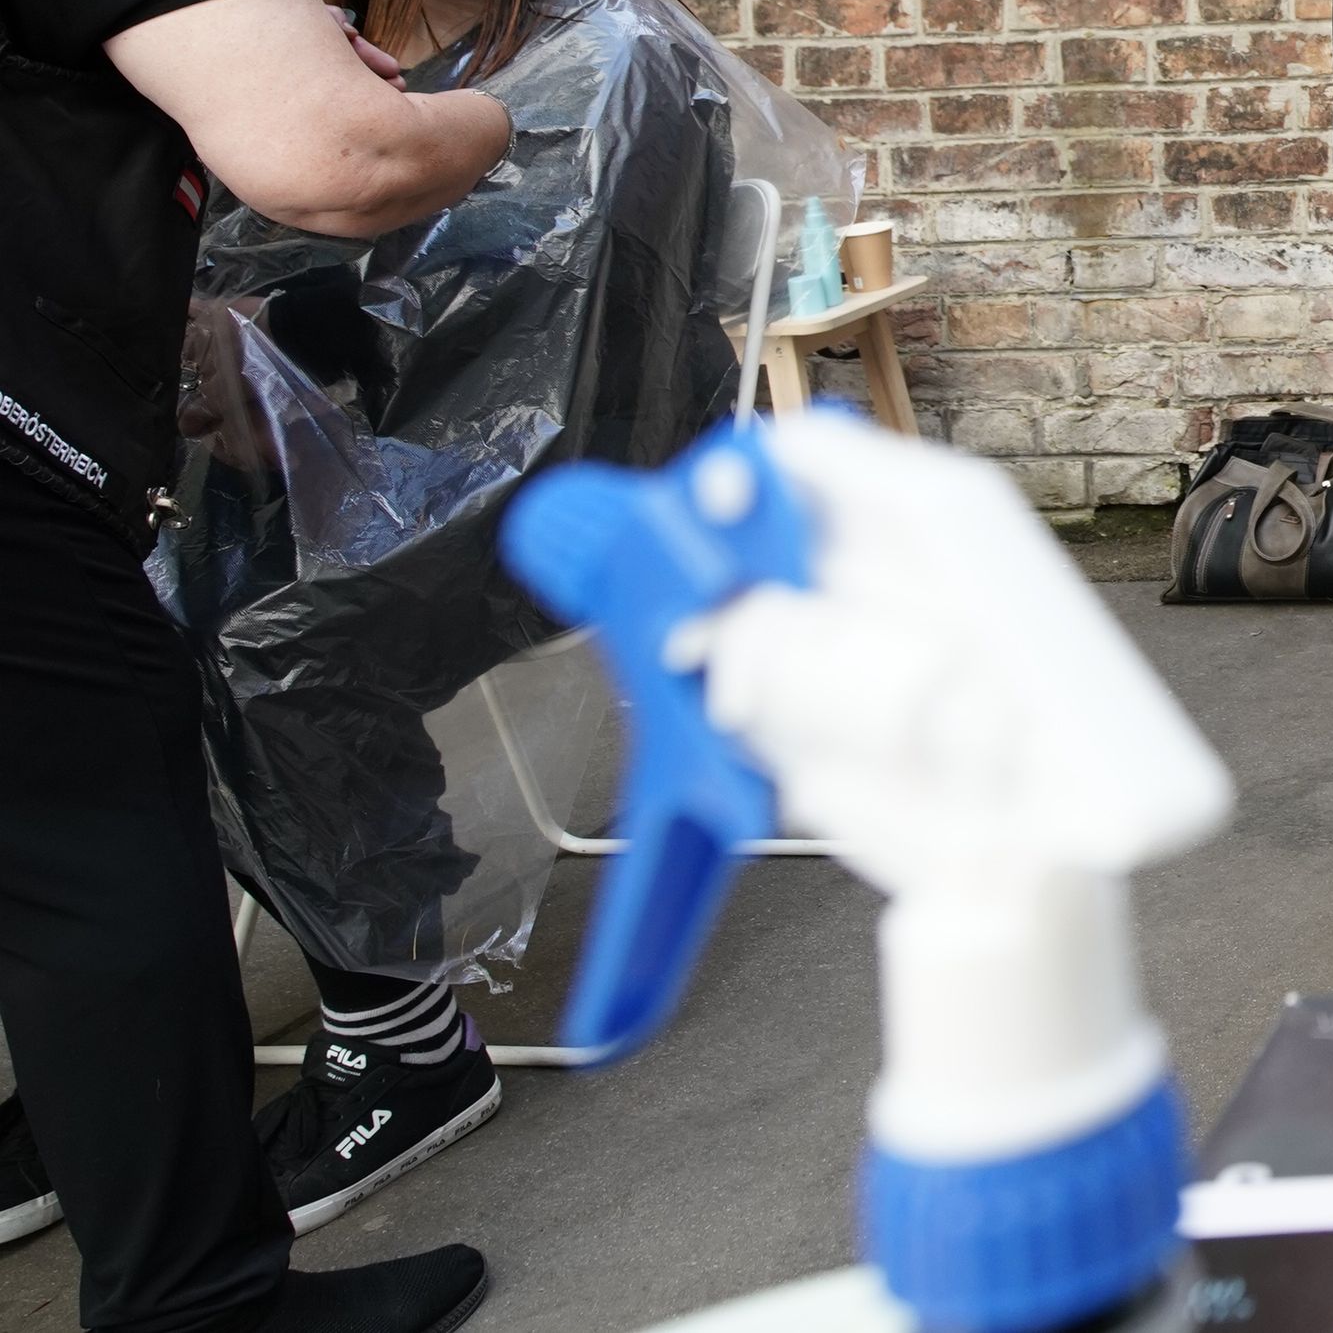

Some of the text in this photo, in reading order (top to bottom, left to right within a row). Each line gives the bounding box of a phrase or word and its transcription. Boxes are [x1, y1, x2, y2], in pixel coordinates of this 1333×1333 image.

[0, 391, 108, 490] BERÖSTERREICH
[326, 1044, 367, 1070] FILA
[335, 1109, 392, 1160] FILA
[426, 1138, 446, 1154] FILA
[454, 1121, 472, 1136] FILA
